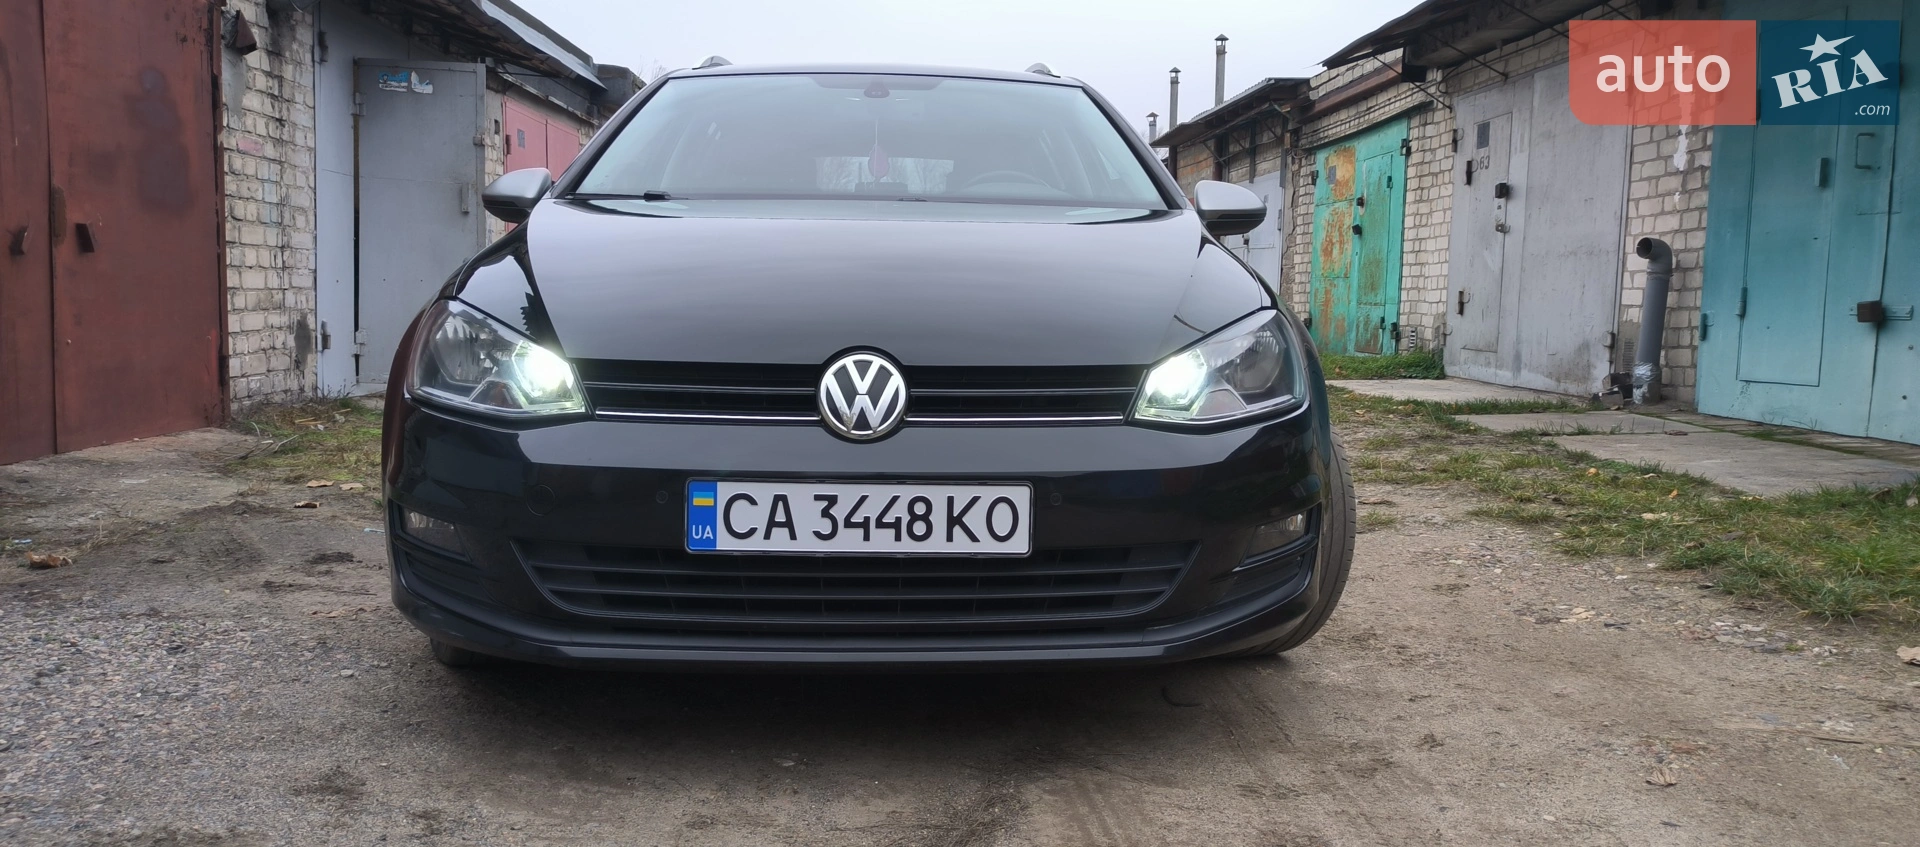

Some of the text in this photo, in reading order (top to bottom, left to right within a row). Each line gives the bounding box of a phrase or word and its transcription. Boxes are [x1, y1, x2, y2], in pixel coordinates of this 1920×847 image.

[692, 525, 714, 540] UA
[722, 491, 1020, 544] CA 3448 KO
